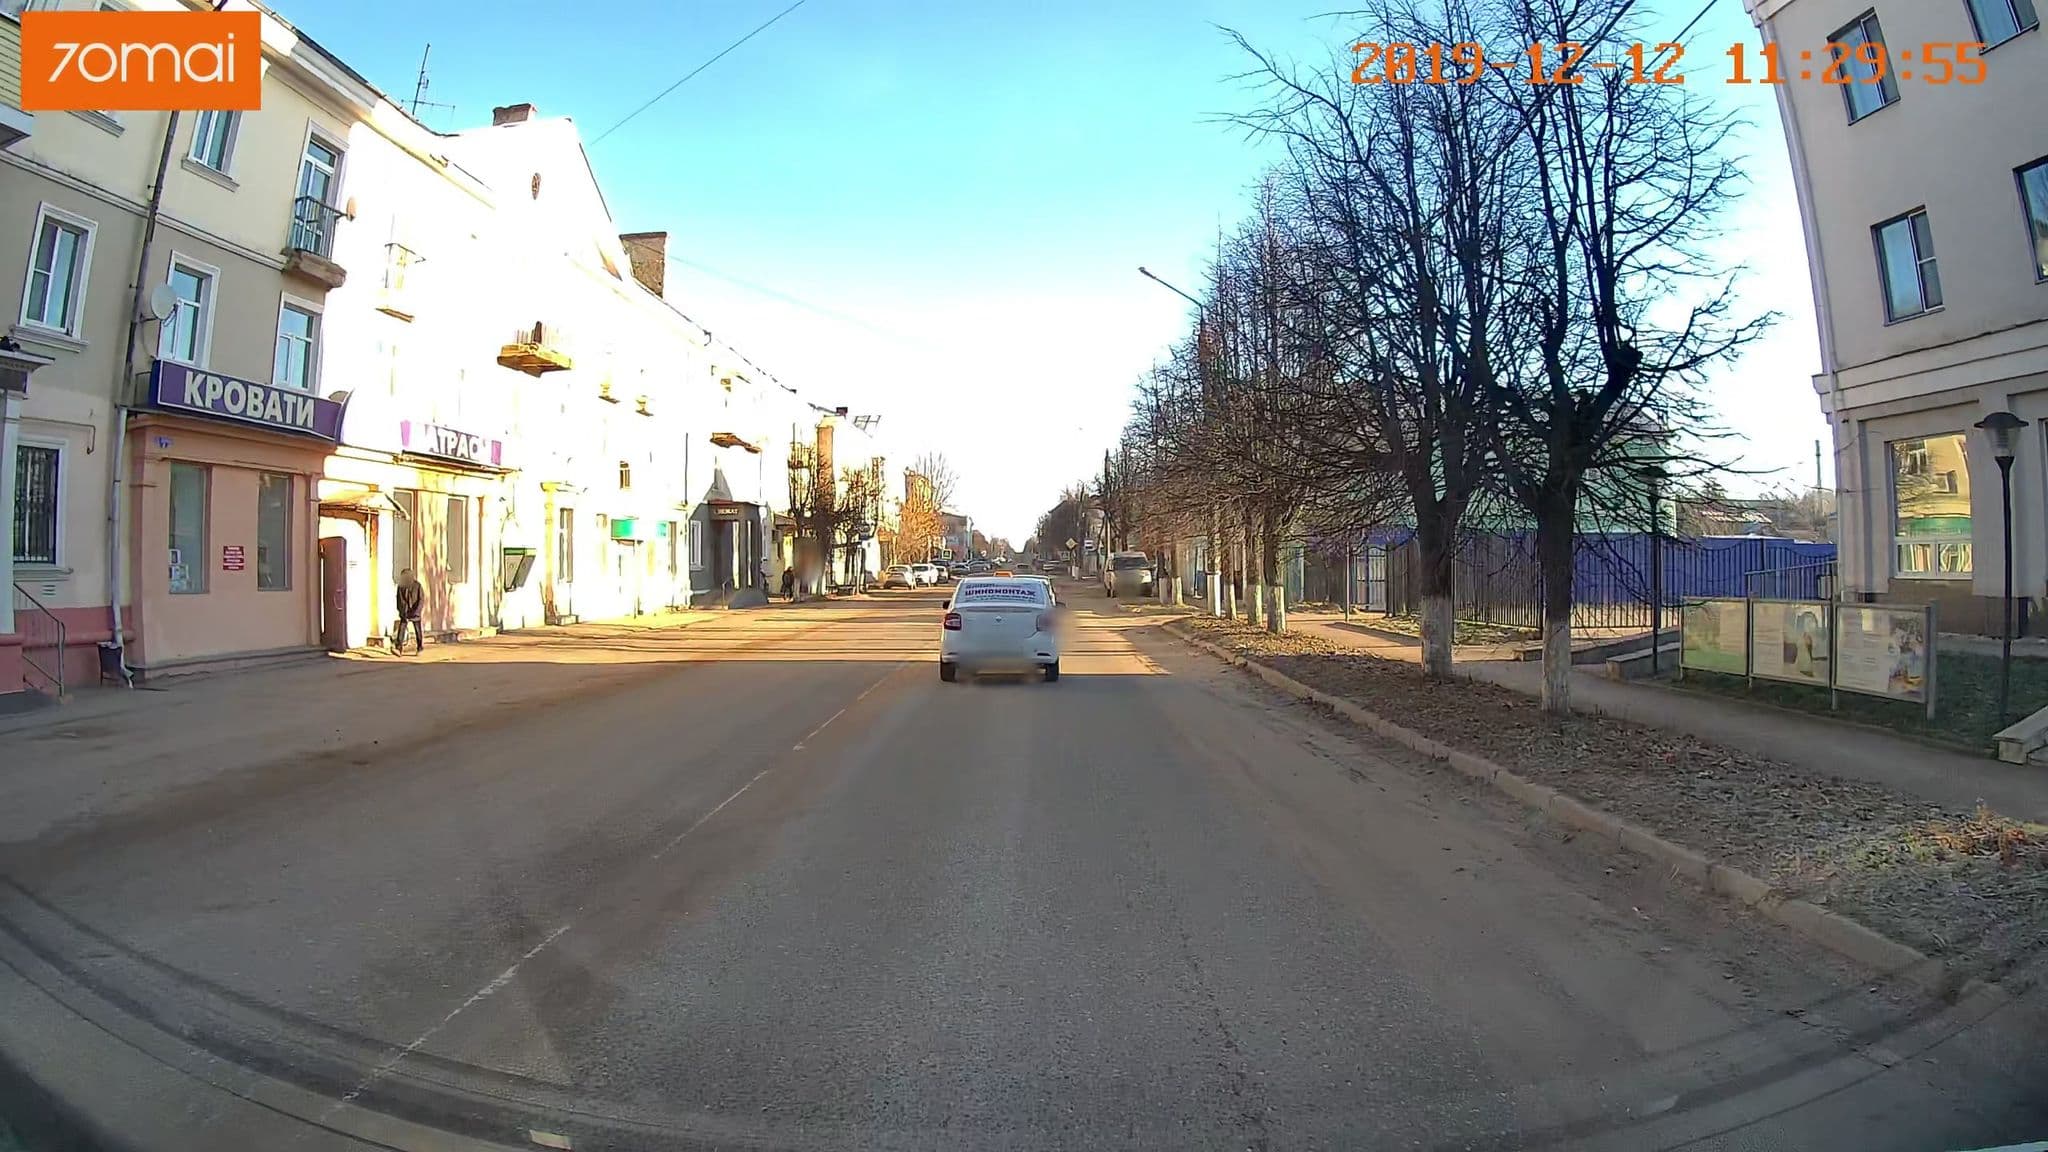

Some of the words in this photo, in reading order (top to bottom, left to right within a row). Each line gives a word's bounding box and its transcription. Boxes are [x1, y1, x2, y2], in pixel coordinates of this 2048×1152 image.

[183, 370, 315, 429] КРОВАТИ
[411, 422, 490, 463] АТРАС
[965, 588, 1036, 597] ШИНОМОНТАЖ
